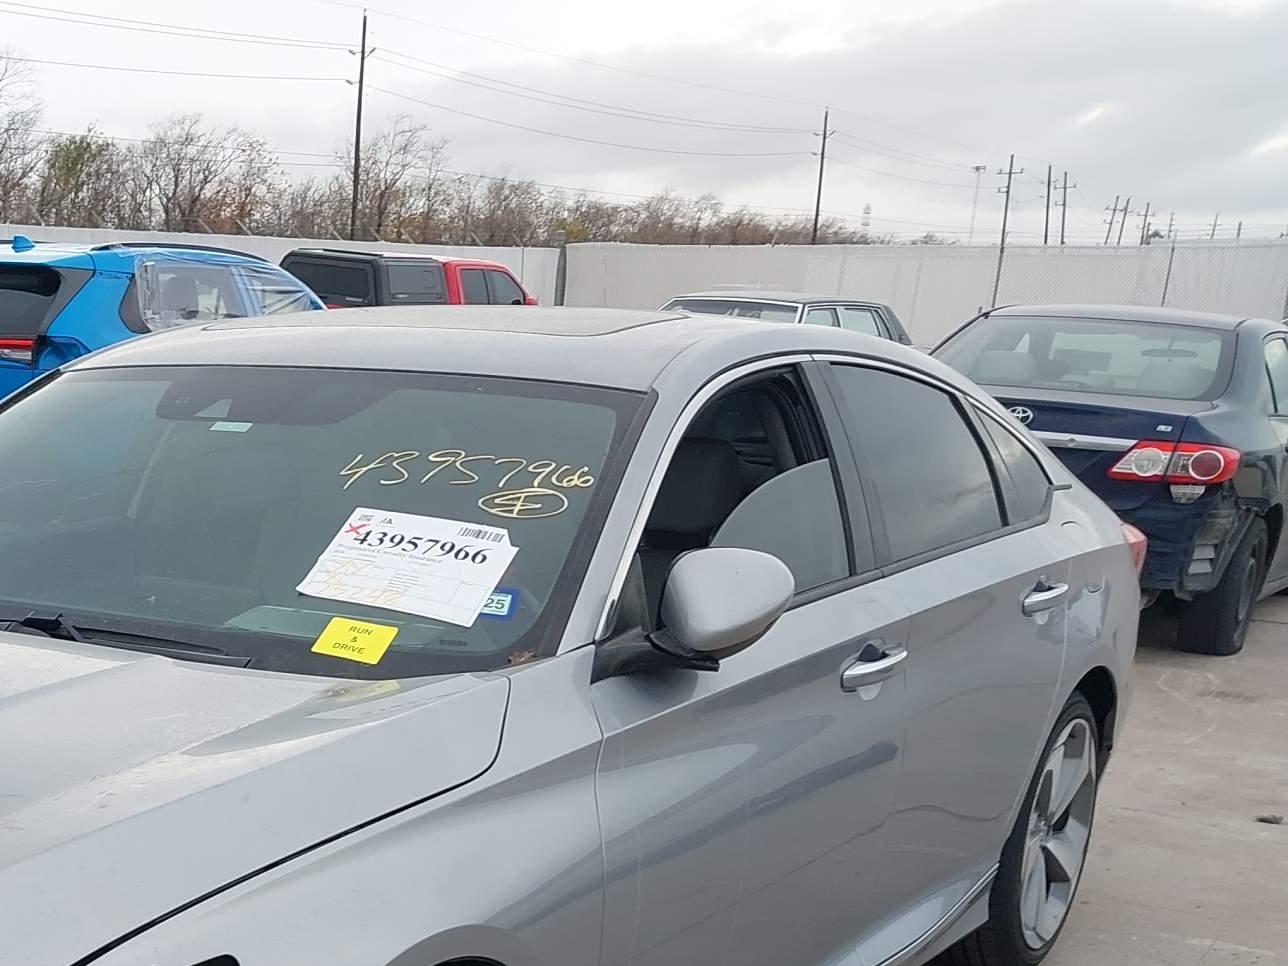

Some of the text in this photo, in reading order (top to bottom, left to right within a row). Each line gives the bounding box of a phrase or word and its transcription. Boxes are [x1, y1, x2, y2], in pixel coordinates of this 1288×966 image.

[339, 449, 595, 490] 43957966
[352, 529, 496, 565] 43957966
[483, 597, 507, 610] 25
[348, 625, 374, 636] RUN
[349, 635, 359, 643] &
[332, 642, 367, 655] DRIVE
